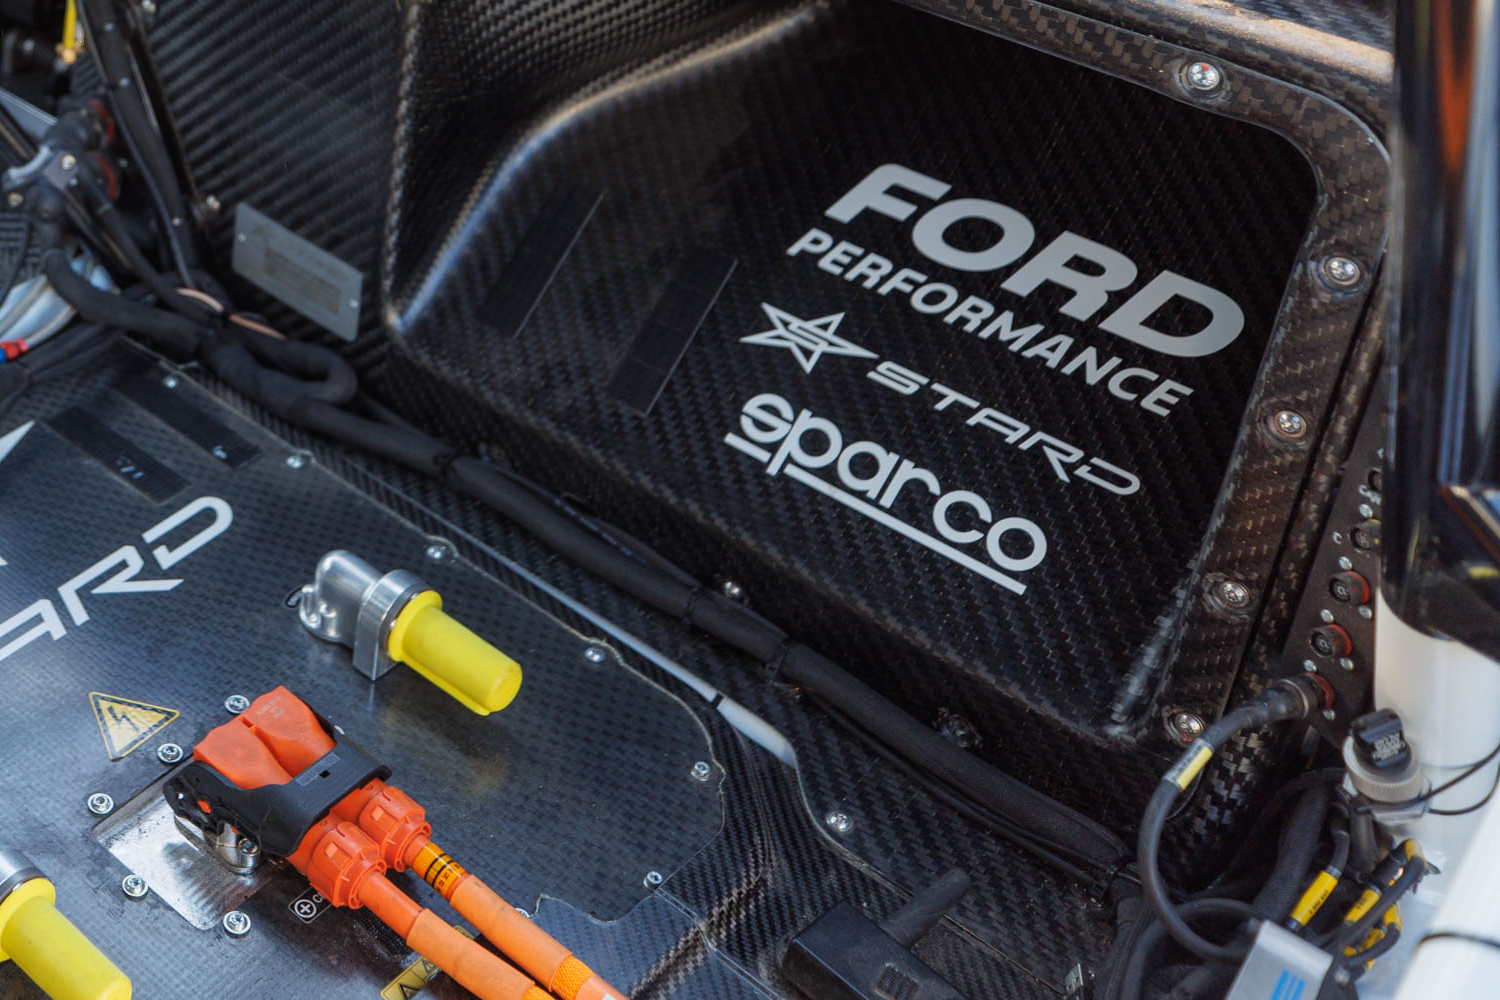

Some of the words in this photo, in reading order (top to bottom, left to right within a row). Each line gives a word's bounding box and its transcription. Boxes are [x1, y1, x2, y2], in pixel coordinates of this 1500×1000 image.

[786, 228, 1194, 417] PERFORMANCE
[824, 162, 1245, 358] FORD
[723, 392, 1048, 596] sparco
[866, 359, 1141, 496] STARD
